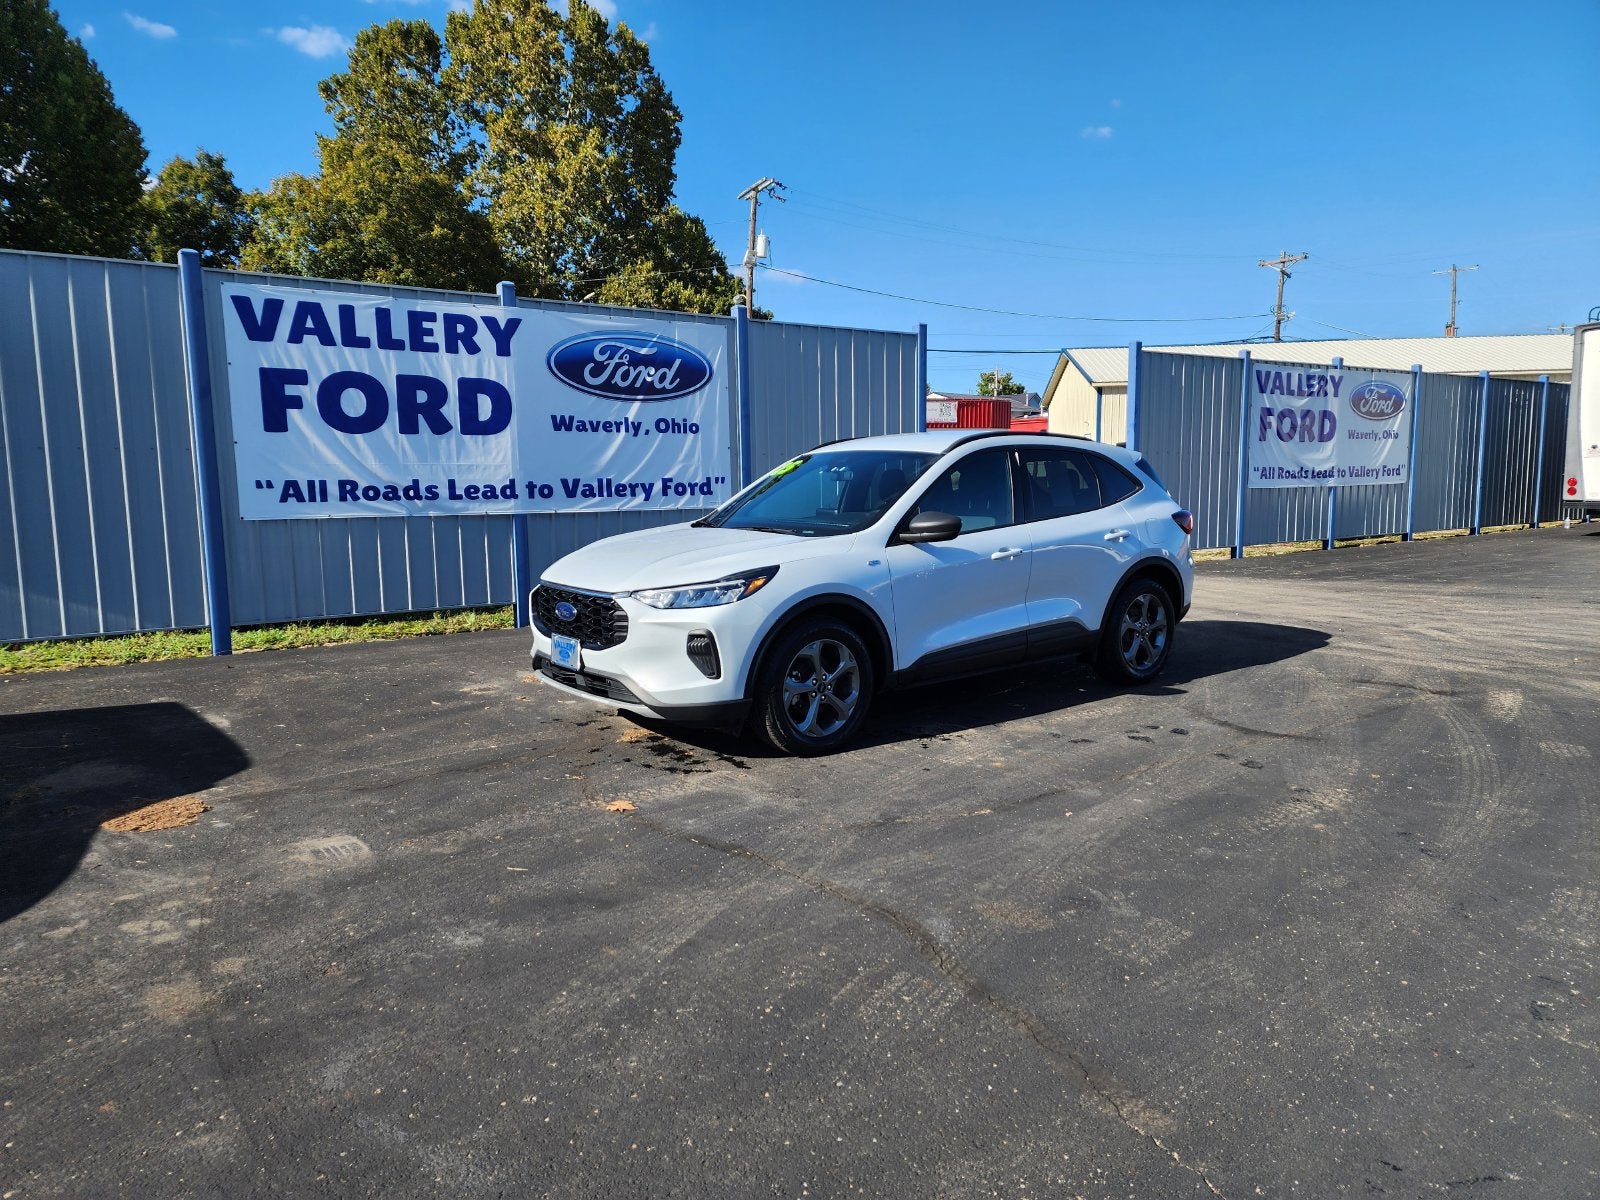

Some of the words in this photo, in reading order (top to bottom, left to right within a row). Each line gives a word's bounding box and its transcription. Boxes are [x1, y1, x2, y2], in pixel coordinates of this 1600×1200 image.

[230, 295, 523, 357] VALLERY
[583, 341, 682, 392] Ford
[1256, 369, 1344, 398] VALLERY
[258, 367, 513, 436] FORD
[1360, 386, 1395, 413] Ford
[551, 414, 651, 436] Waverly,
[655, 416, 700, 435] Ohio
[1259, 406, 1337, 443] FORD
[1348, 429, 1381, 442] Waverly,
[1382, 431, 1399, 440] Ohio
[1253, 466, 1275, 480] "All
[1277, 466, 1309, 480] Roads
[1310, 466, 1335, 480] Lead
[1337, 468, 1347, 479] to
[1349, 466, 1380, 480] Vallery
[1381, 464, 1406, 477] Ford"
[255, 479, 329, 503] "All
[338, 479, 439, 502] Roads
[448, 478, 519, 501] Lead
[526, 480, 553, 499] to
[562, 477, 655, 502] Vallery
[661, 475, 727, 498] Ford"
